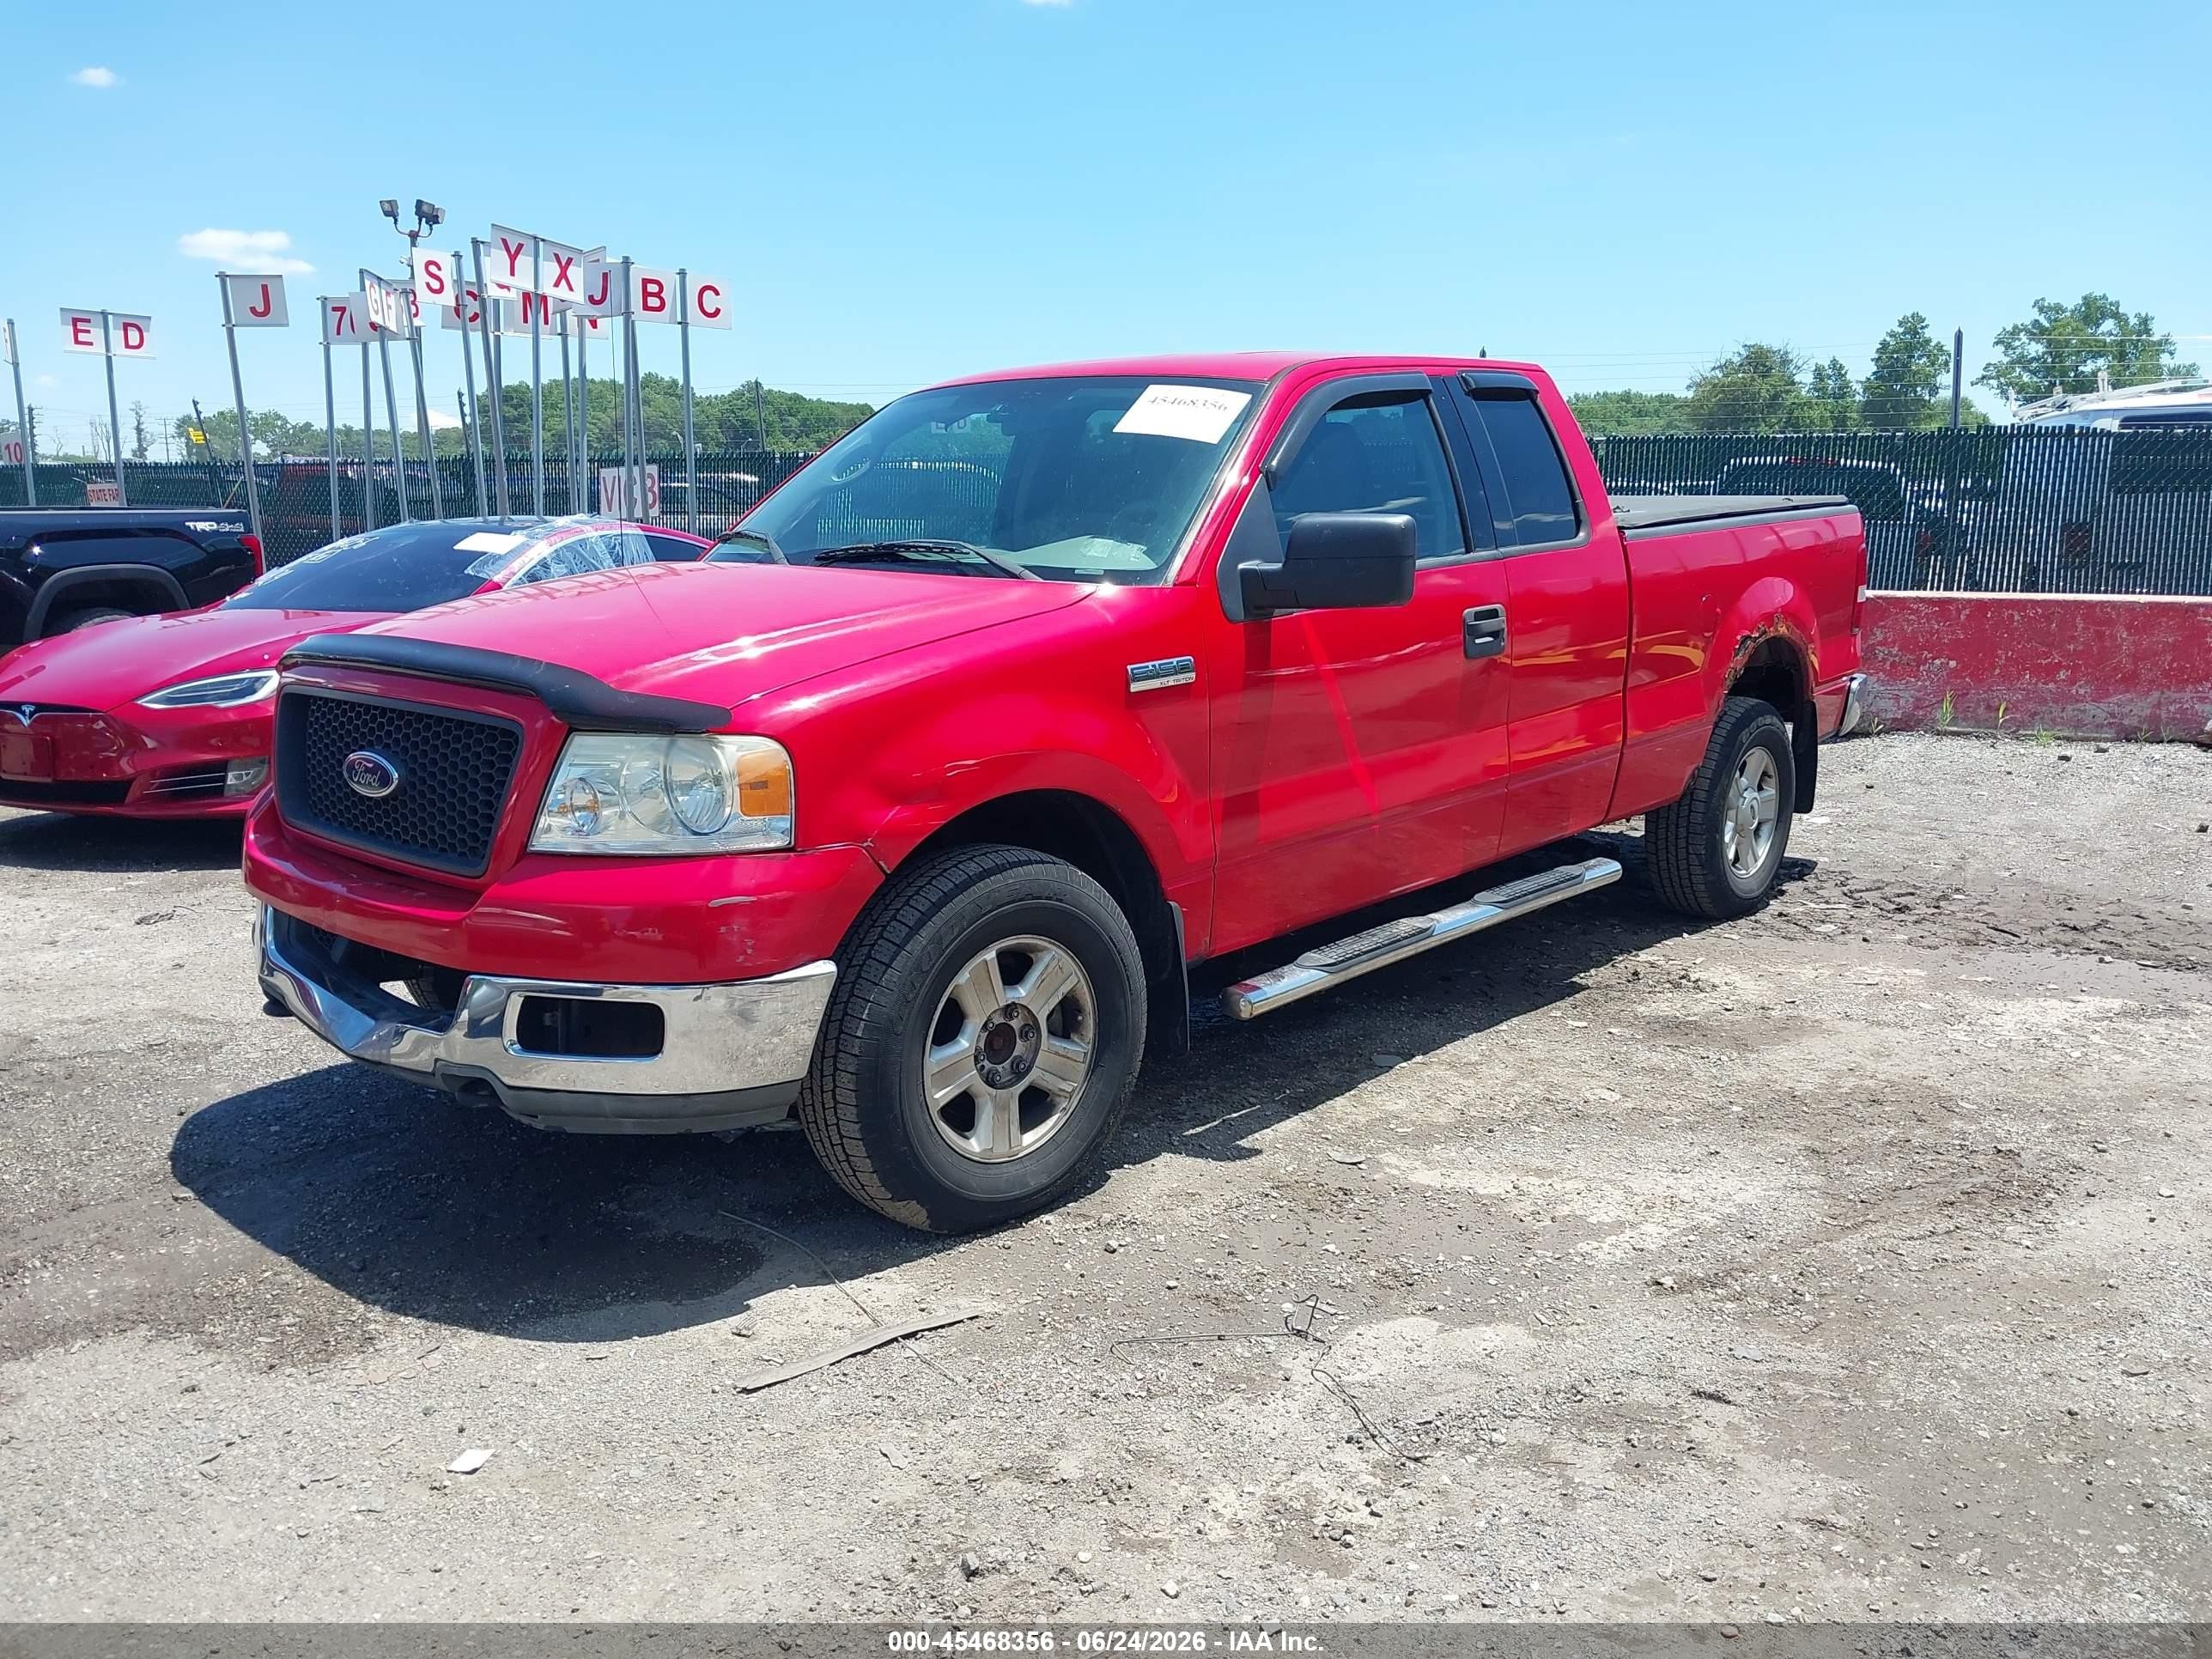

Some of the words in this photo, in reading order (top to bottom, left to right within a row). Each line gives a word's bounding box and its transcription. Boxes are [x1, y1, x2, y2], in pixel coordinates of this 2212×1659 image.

[500, 237, 526, 277] Y
[552, 252, 575, 293] X
[424, 259, 445, 295] S
[587, 271, 609, 306] J
[248, 283, 271, 318] J
[521, 291, 550, 326] M
[641, 277, 667, 313] B
[697, 284, 721, 319] C
[71, 317, 94, 347] E
[122, 321, 145, 350] D
[4, 441, 23, 464] 10
[88, 489, 108, 502] STATE
[108, 488, 119, 502] FAR
[185, 521, 217, 532] TRD
[352, 760, 380, 787] Ford
